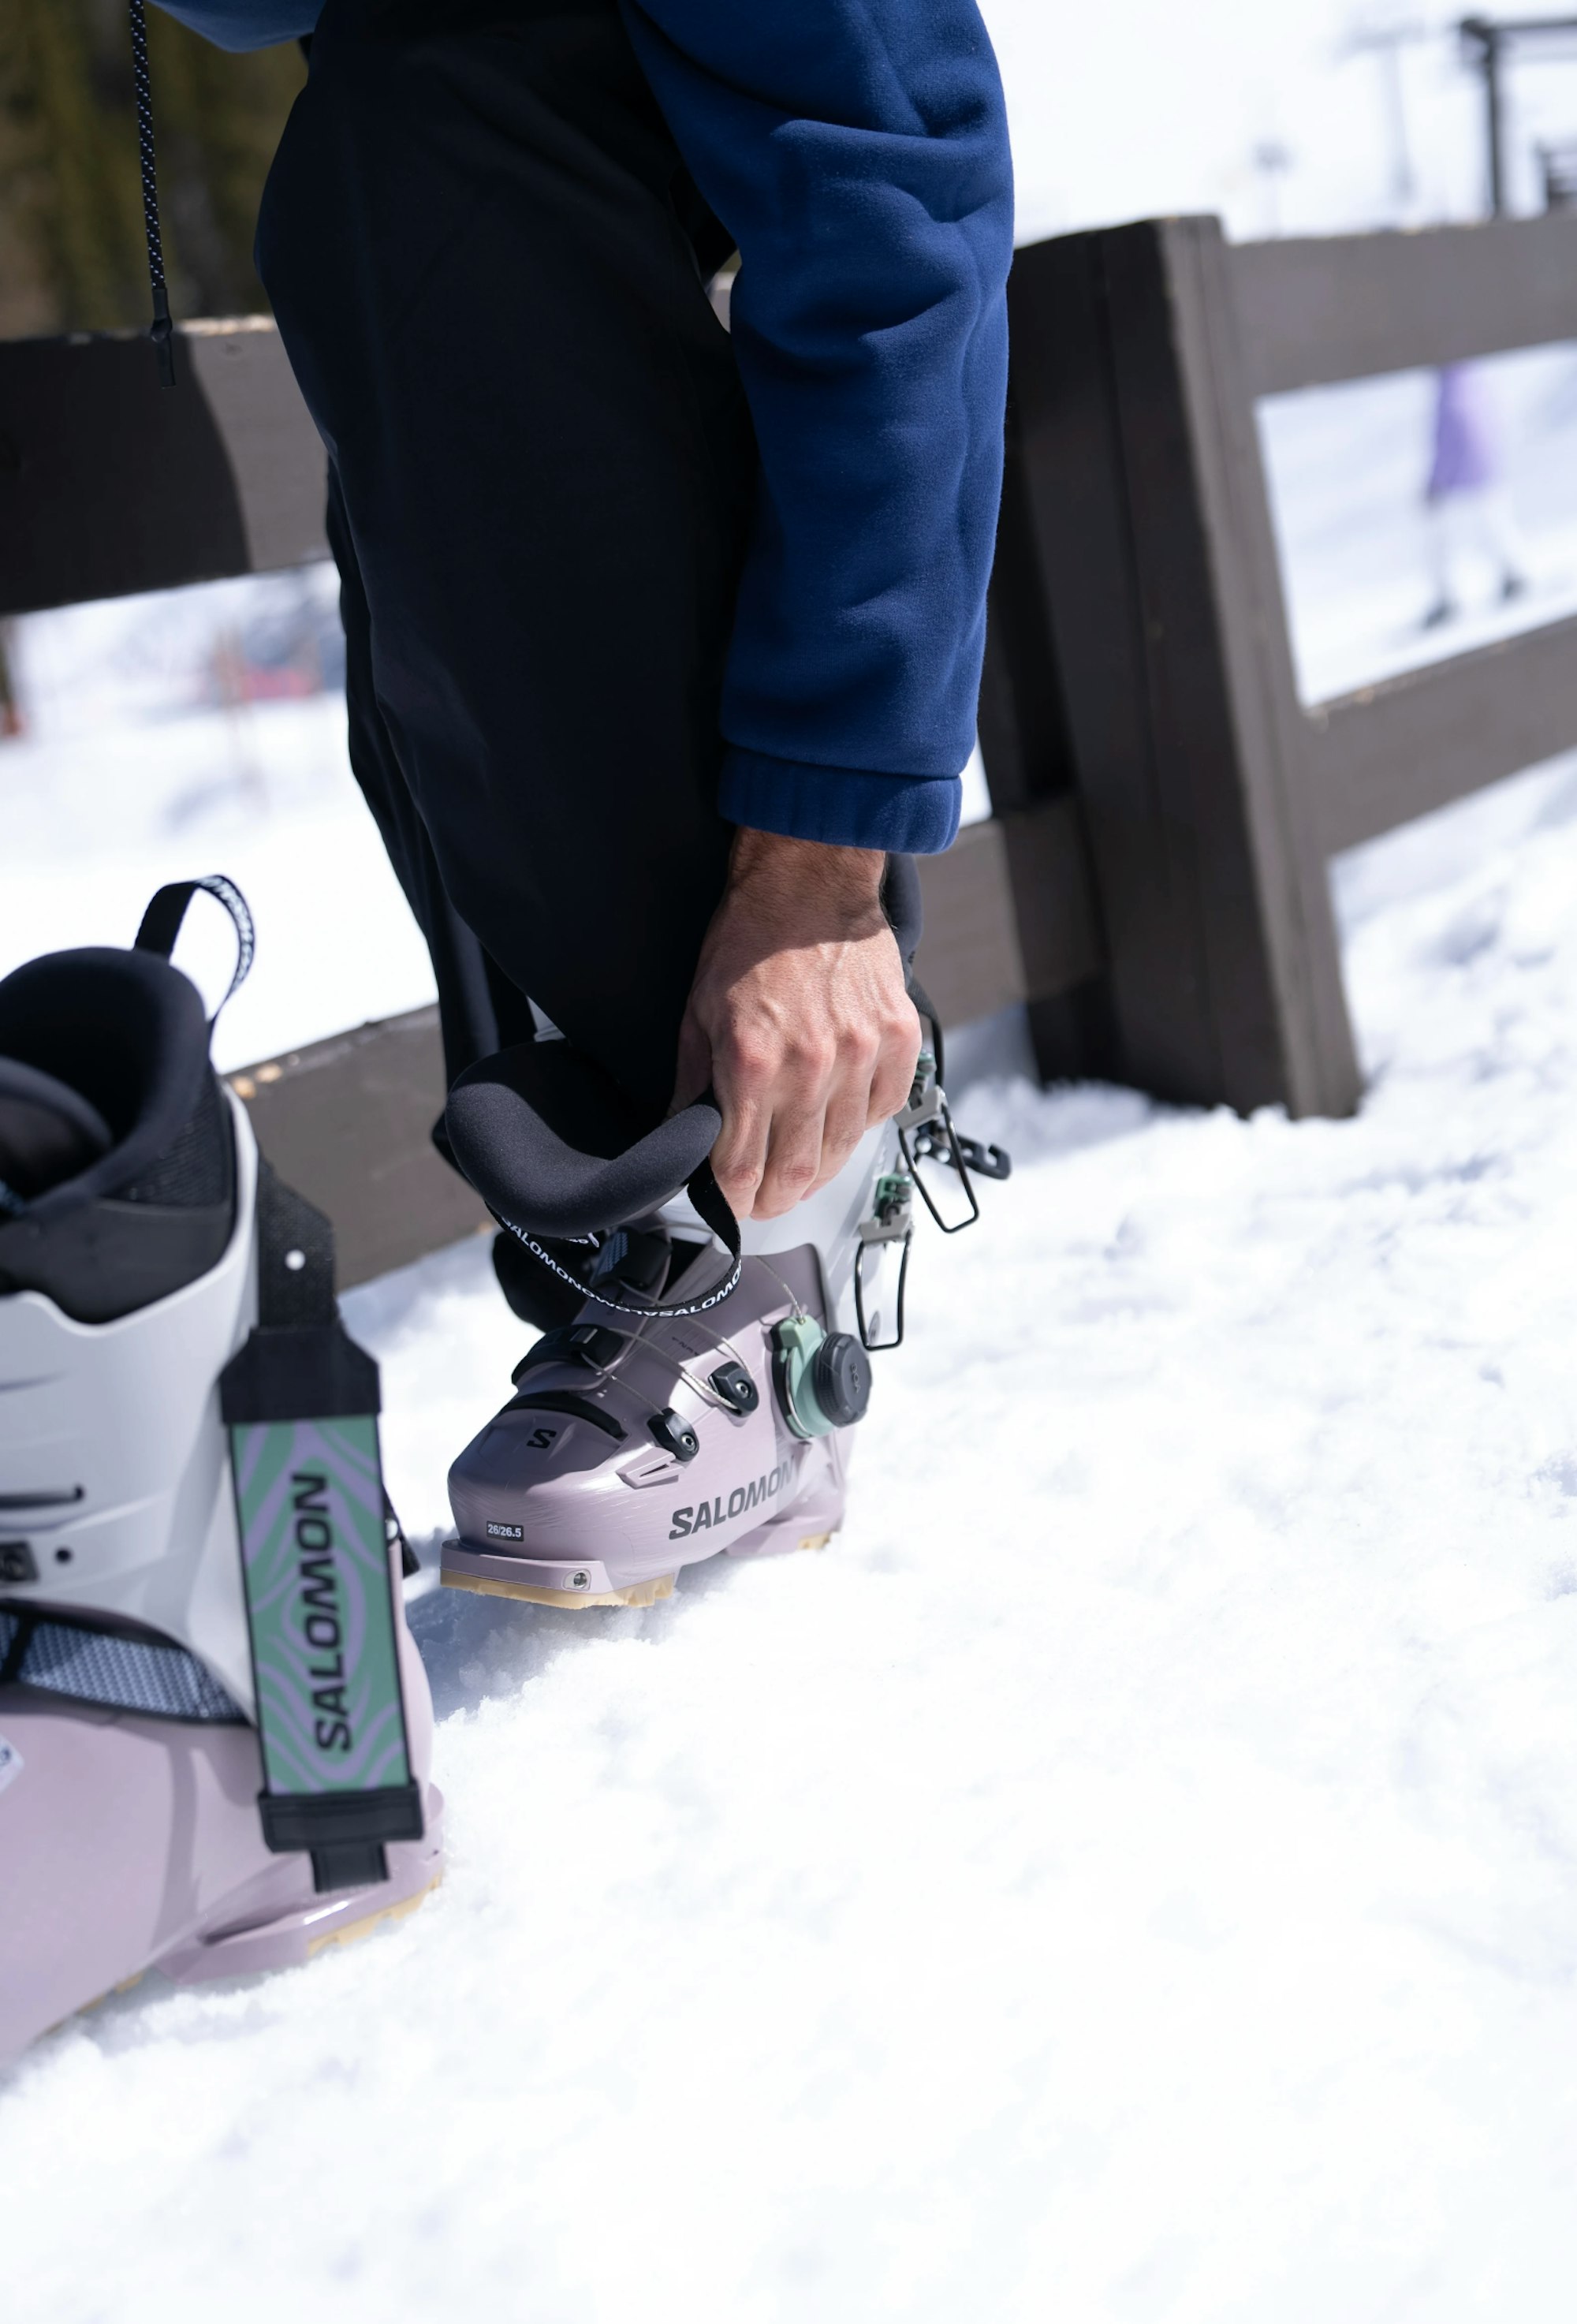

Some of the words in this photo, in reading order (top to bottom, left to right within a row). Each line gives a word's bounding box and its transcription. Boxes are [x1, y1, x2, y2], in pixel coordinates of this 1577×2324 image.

[487, 1524, 522, 1538] 26/26.5
[669, 1454, 795, 1540] SALOMON
[290, 1472, 352, 1753] SALOMON
